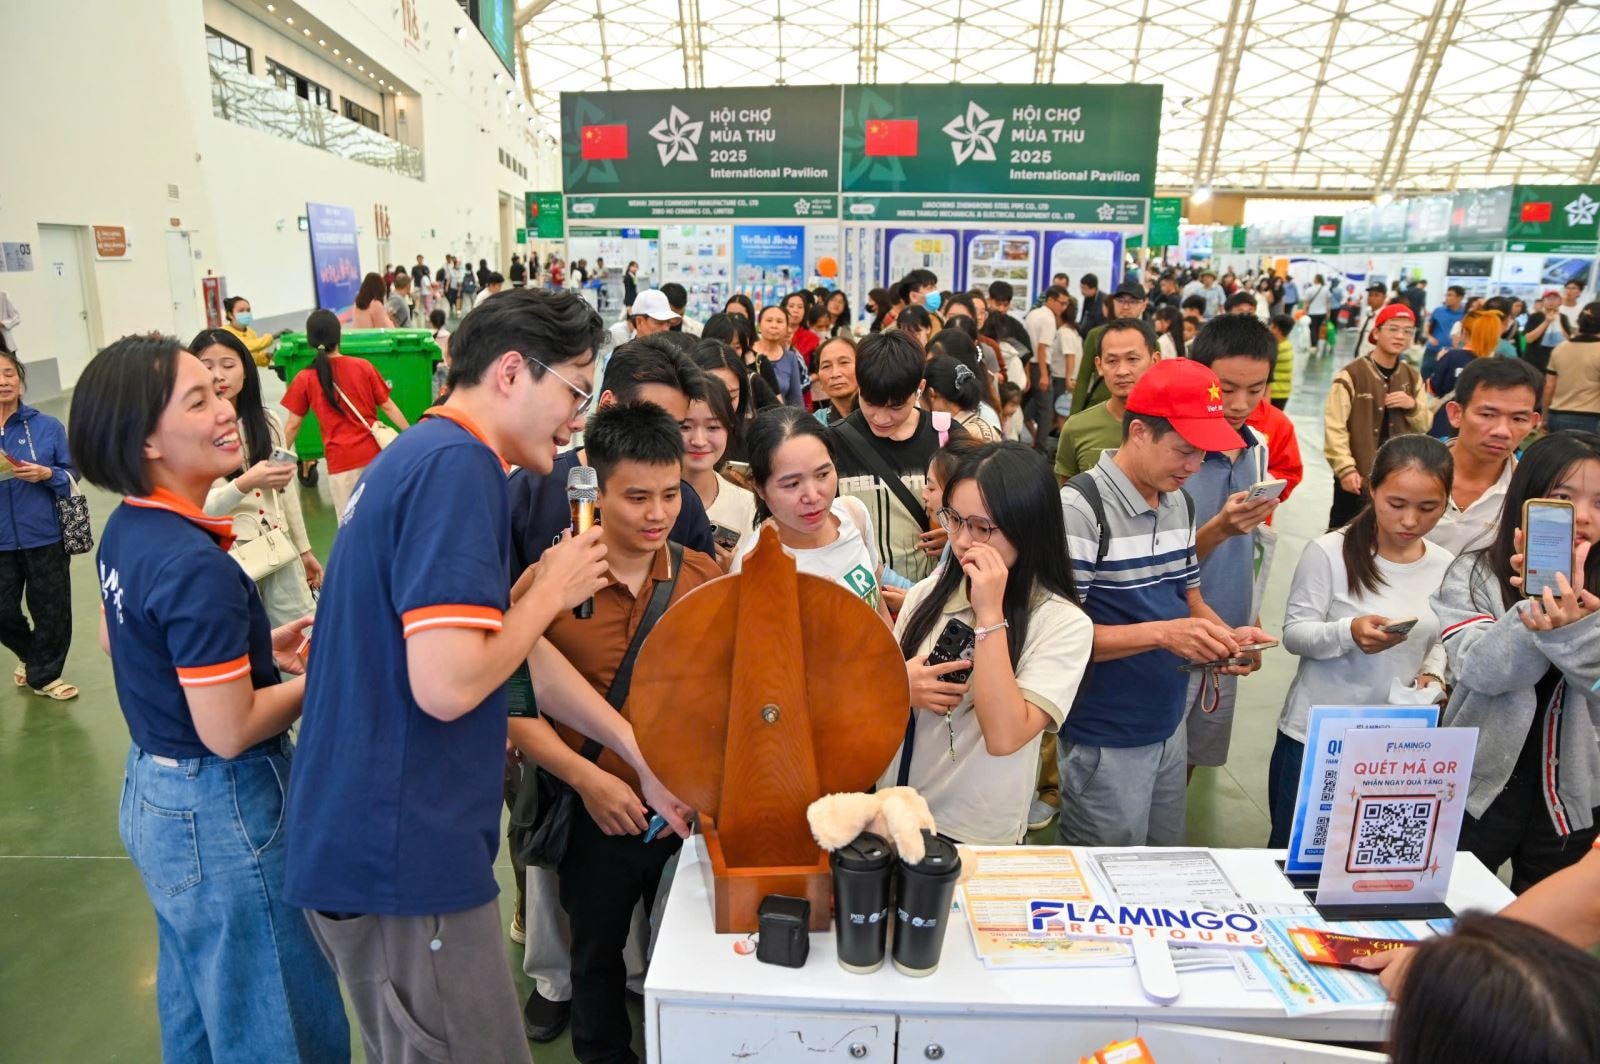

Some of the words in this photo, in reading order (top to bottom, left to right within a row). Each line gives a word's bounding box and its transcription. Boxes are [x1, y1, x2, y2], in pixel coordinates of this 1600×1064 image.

[710, 107, 736, 128] HỘI
[739, 107, 772, 126] CHỢ
[1012, 105, 1041, 127] HỘI
[1045, 106, 1082, 126] CHỢ
[710, 127, 742, 143] MÙA
[746, 129, 776, 142] THU
[1011, 126, 1048, 143] MÙA
[1051, 129, 1085, 143] THU
[710, 150, 748, 163] 2025
[1010, 150, 1052, 163] 2025
[710, 167, 781, 179] International
[783, 167, 828, 179] Pavilion
[1009, 169, 1088, 182] International
[1090, 170, 1140, 183] Pavilion
[19, 243, 31, 256] 03
[850, 569, 871, 593] R
[1386, 742, 1432, 753] FLAMINGO
[1354, 760, 1398, 776] QUÉT
[1402, 758, 1427, 775] MÃ
[1432, 760, 1458, 775] QR
[1030, 901, 1258, 933] FLAMINGO
